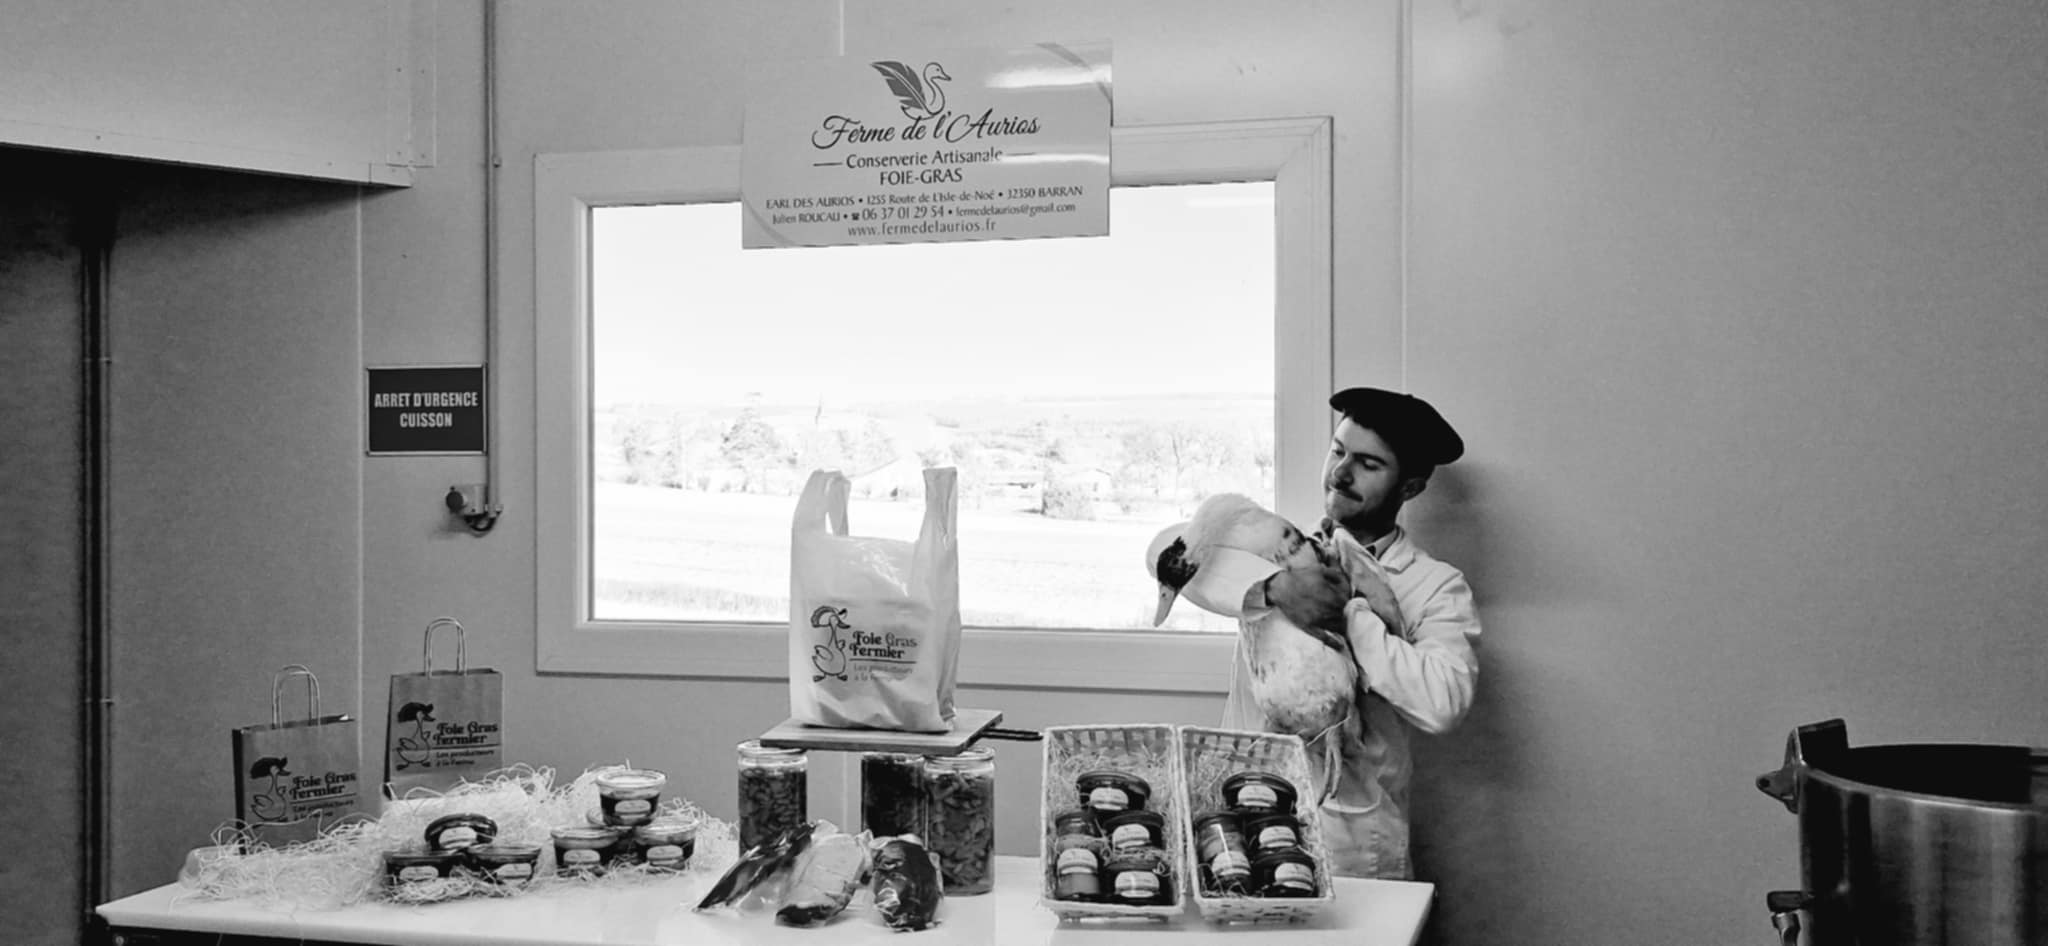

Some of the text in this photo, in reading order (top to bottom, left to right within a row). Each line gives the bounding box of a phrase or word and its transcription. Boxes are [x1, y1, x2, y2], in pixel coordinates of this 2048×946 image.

[812, 108, 1041, 149] Ferme de l'Aurios
[846, 147, 1003, 169] Conserverie Artisanale
[879, 168, 963, 186] FOIE-GRAS
[766, 199, 791, 210] EARL
[793, 199, 814, 208] DES
[816, 196, 855, 208] AURIOS
[867, 194, 886, 206] 1255
[888, 193, 916, 204] Route
[918, 192, 930, 203] de
[1007, 187, 1036, 199] 32350
[1038, 185, 1083, 198] BARRAN
[772, 213, 797, 224] Julien
[862, 207, 877, 220] 06
[880, 207, 894, 220] 37
[897, 206, 910, 219] 01
[914, 205, 928, 219] 29
[931, 205, 945, 218] 54
[848, 218, 997, 236] www.fermedelaurios.fr
[374, 391, 478, 408] ARRET D'URGENCE
[399, 412, 453, 427] CUISSON
[852, 630, 918, 648] Foie Gras
[849, 642, 905, 659] Fermier
[436, 721, 498, 738] Foie Gras
[432, 733, 488, 745] Fermier
[292, 771, 357, 789] Foie Gras
[289, 784, 346, 800] Fermier
